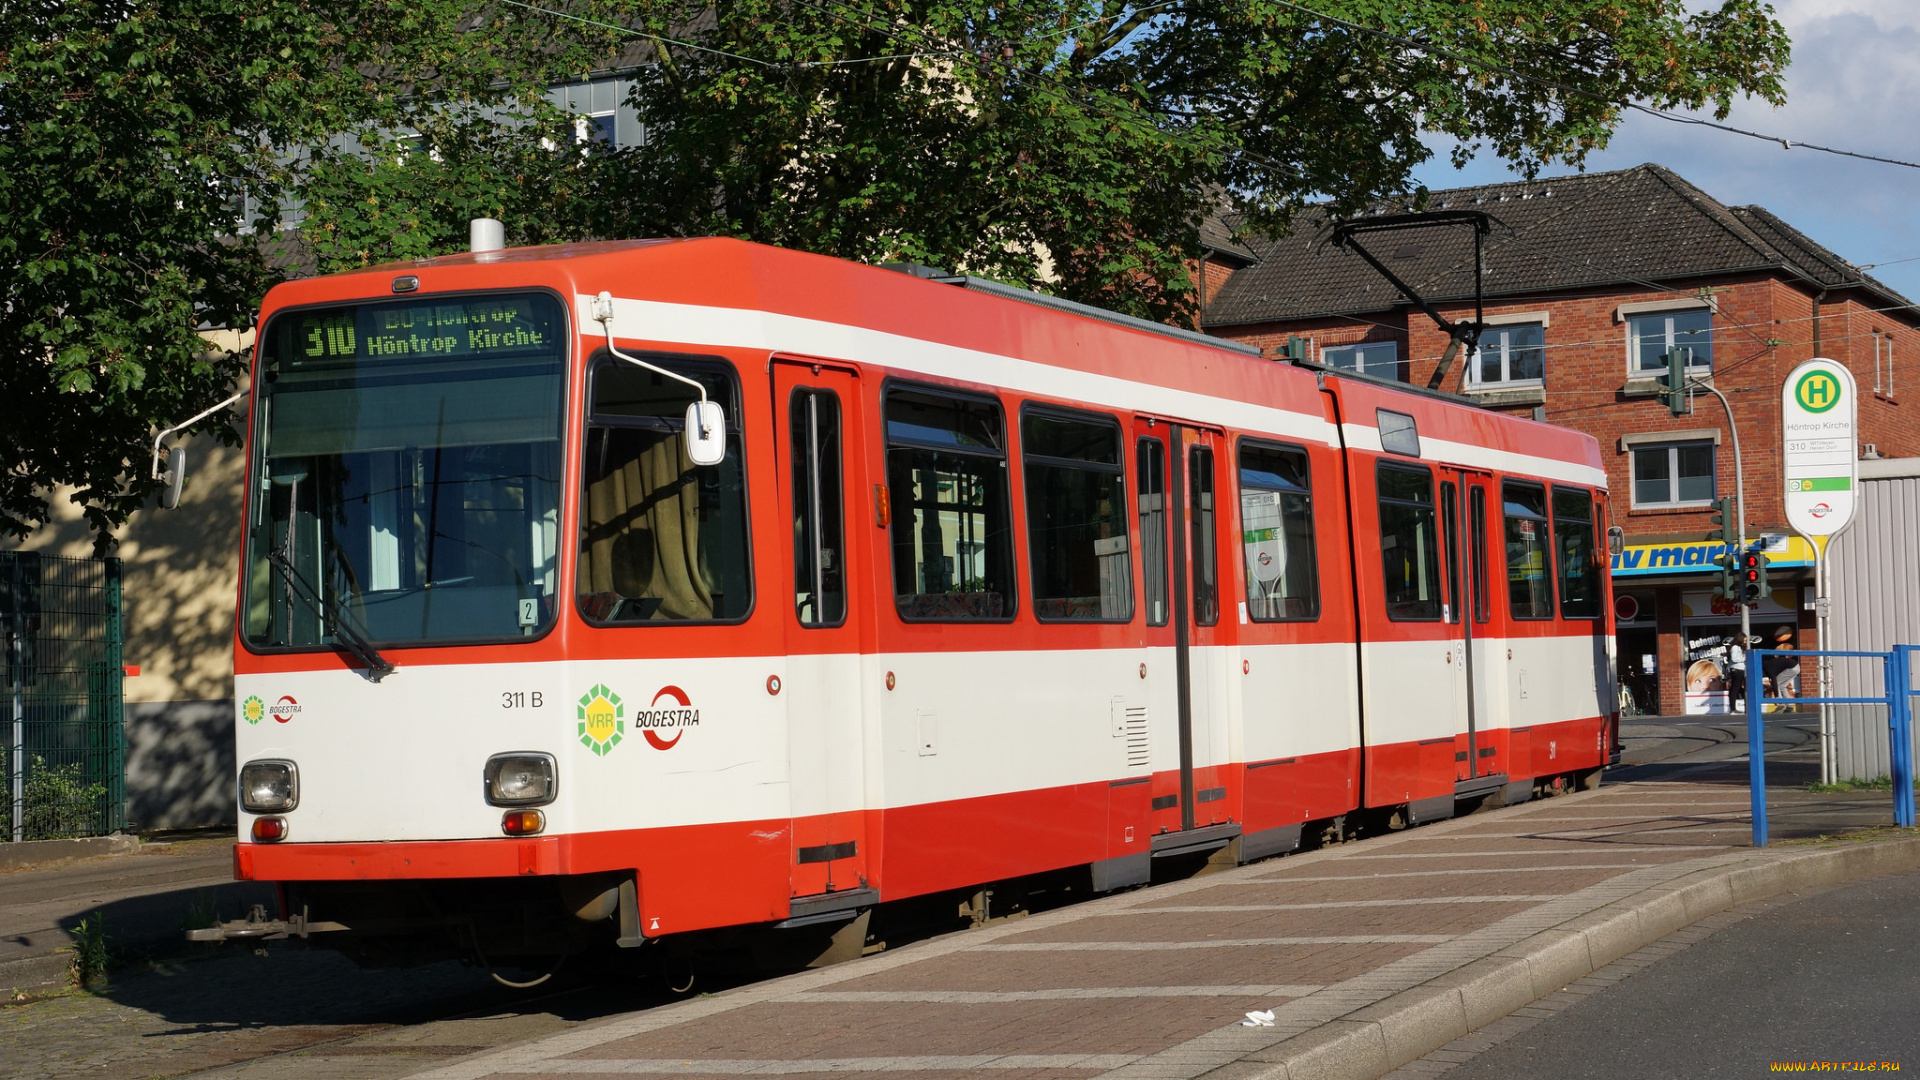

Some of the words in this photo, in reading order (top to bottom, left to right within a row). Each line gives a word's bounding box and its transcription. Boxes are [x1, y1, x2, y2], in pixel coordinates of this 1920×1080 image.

[303, 317, 356, 357] 310
[367, 334, 457, 355] Höntrop
[468, 327, 543, 349] Kirche
[1808, 380, 1828, 404] H
[1787, 423, 1821, 432] Höntrop
[1823, 422, 1849, 430] Kirche
[1789, 442, 1806, 451] 310
[525, 602, 532, 620] 2
[1689, 635, 1721, 649] Belegte
[1689, 646, 1727, 661] Brötchen
[502, 692, 525, 709] 311
[531, 691, 543, 708] B
[269, 705, 302, 714] BOGESTRA
[587, 713, 614, 728] VRR
[635, 709, 700, 728] BOGESTRA
